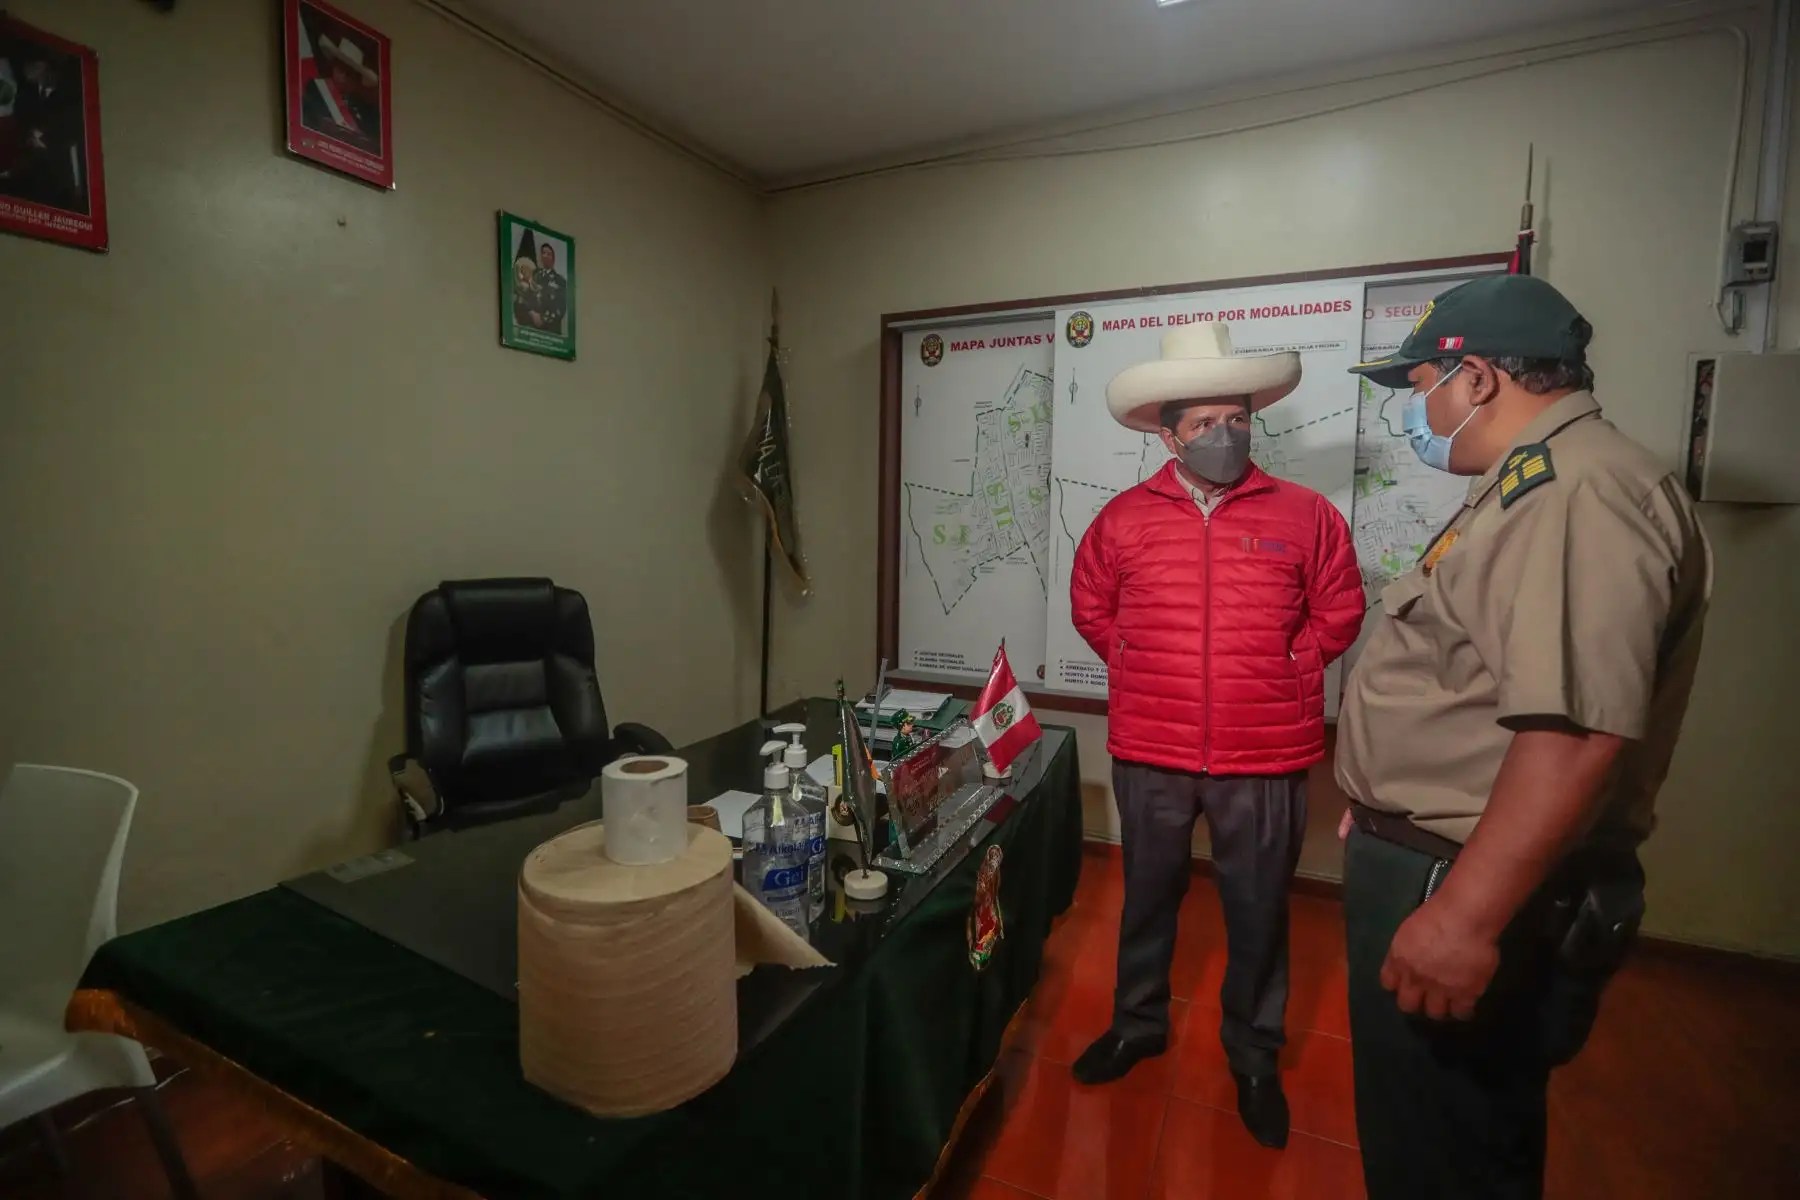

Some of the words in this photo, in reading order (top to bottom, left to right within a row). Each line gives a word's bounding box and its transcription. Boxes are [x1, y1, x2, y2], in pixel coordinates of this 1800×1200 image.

[1103, 318, 1136, 332] MAPA
[1140, 316, 1163, 327] DEL
[1168, 311, 1213, 326] DELITO
[1218, 308, 1245, 322] POR
[1250, 300, 1352, 319] MODALIDADES
[950, 339, 985, 352] MAPA
[989, 334, 1042, 348] JUNTAS
